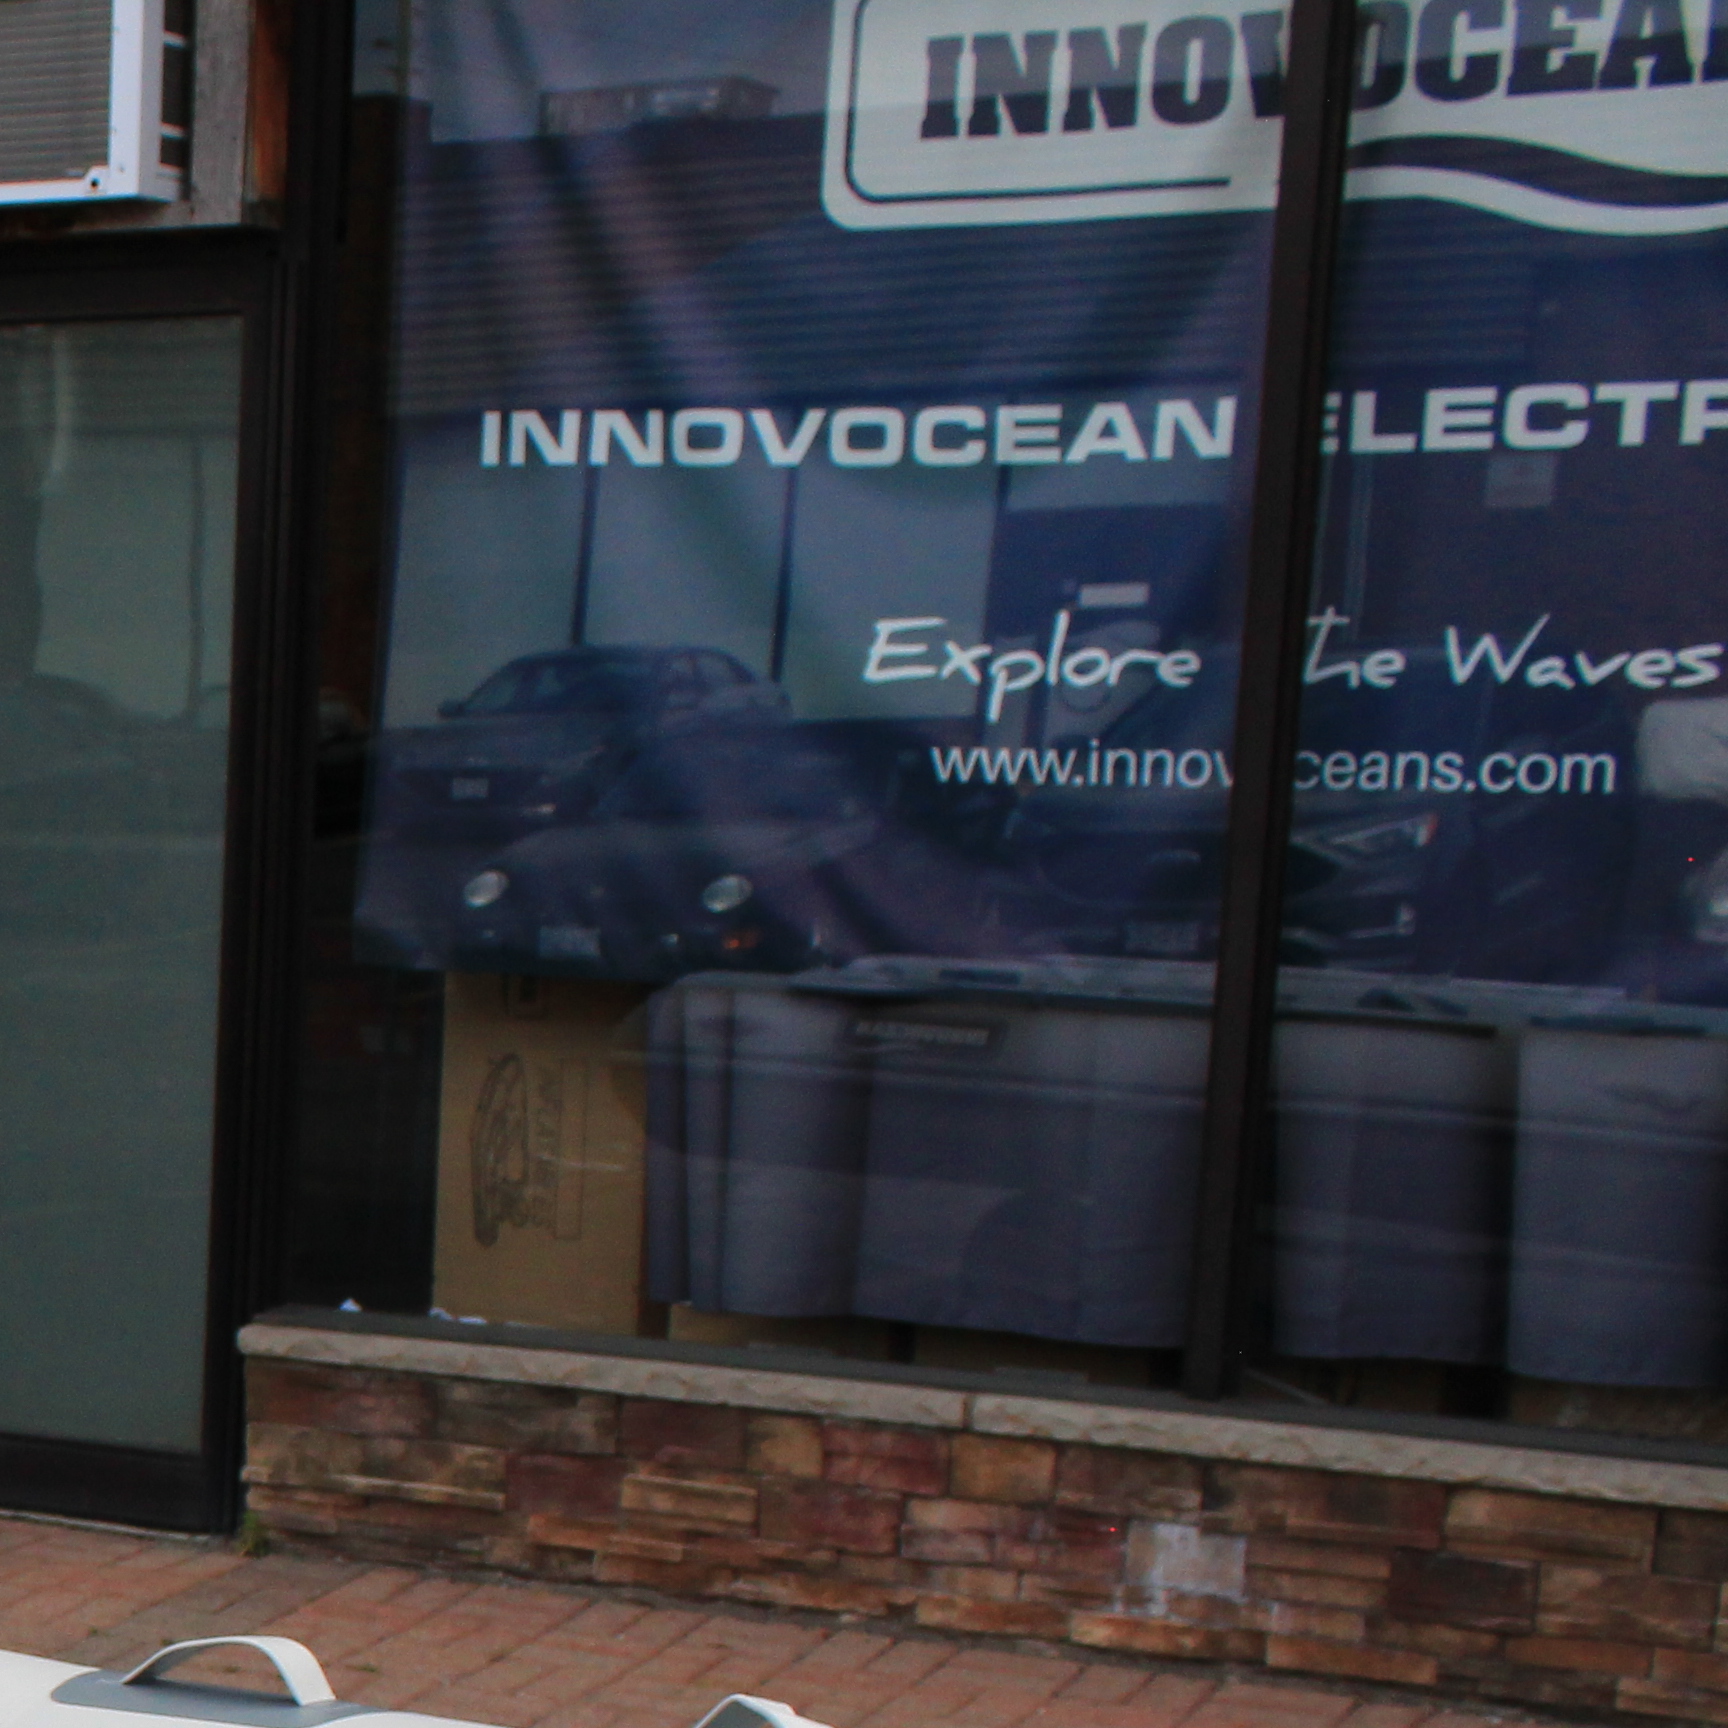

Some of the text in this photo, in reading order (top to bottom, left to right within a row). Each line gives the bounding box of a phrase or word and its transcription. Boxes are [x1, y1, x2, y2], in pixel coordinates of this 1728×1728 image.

[920, 0, 1728, 139] INNOVOCEA
[480, 379, 1728, 467] INNOVOCEAN LECTR
[862, 608, 1202, 723] Explore
[1445, 612, 1726, 690] Waves
[929, 738, 1618, 795] www.innovceans.com
